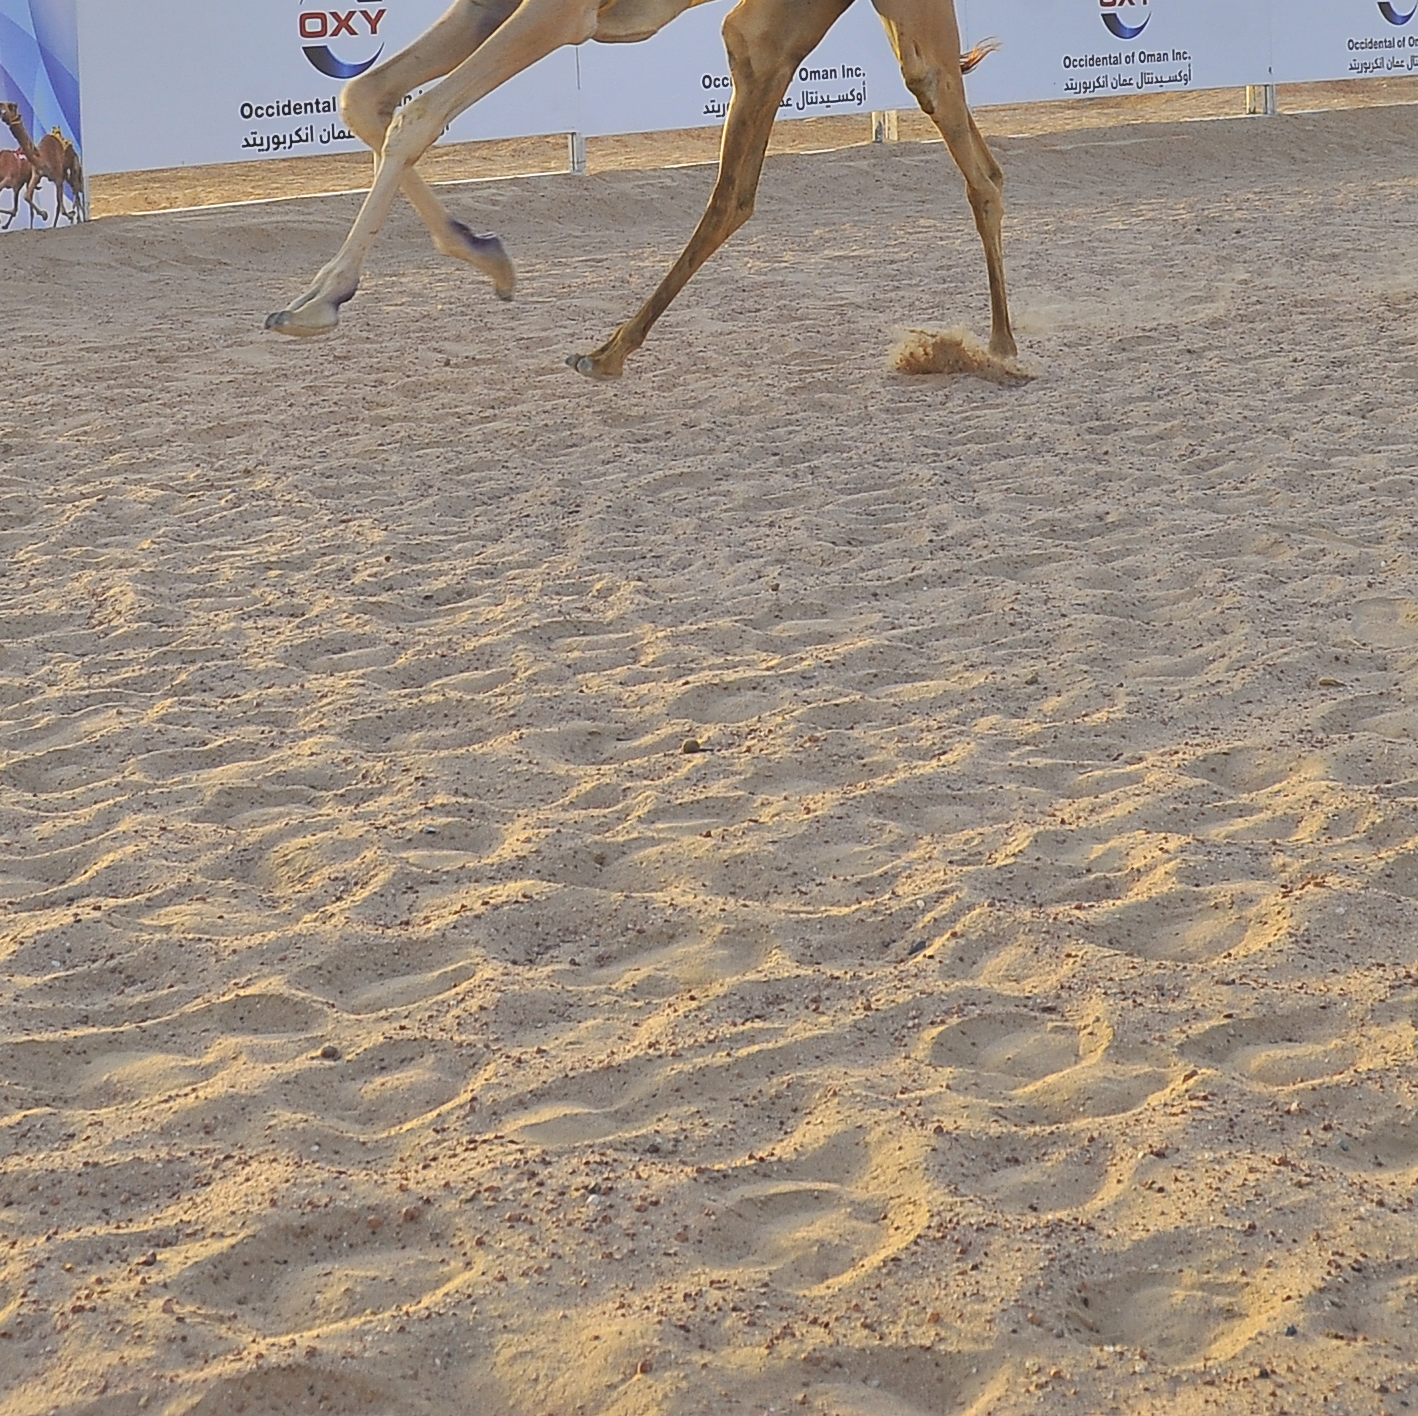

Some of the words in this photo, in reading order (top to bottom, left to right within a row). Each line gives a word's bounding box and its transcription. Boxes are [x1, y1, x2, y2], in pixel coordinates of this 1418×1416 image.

[299, 9, 387, 38] OXY
[1347, 37, 1395, 50] Occidental
[1397, 37, 1406, 48] of
[1063, 52, 1122, 68] Occidental
[1125, 51, 1135, 64] of
[1138, 50, 1168, 63] Oman
[1172, 49, 1191, 61] Inc.
[1386, 56, 1405, 71] عمان
[799, 67, 837, 81] Oman
[842, 65, 866, 78] Inc.
[1111, 73, 1133, 89] عمان
[240, 96, 337, 119] Occidental
